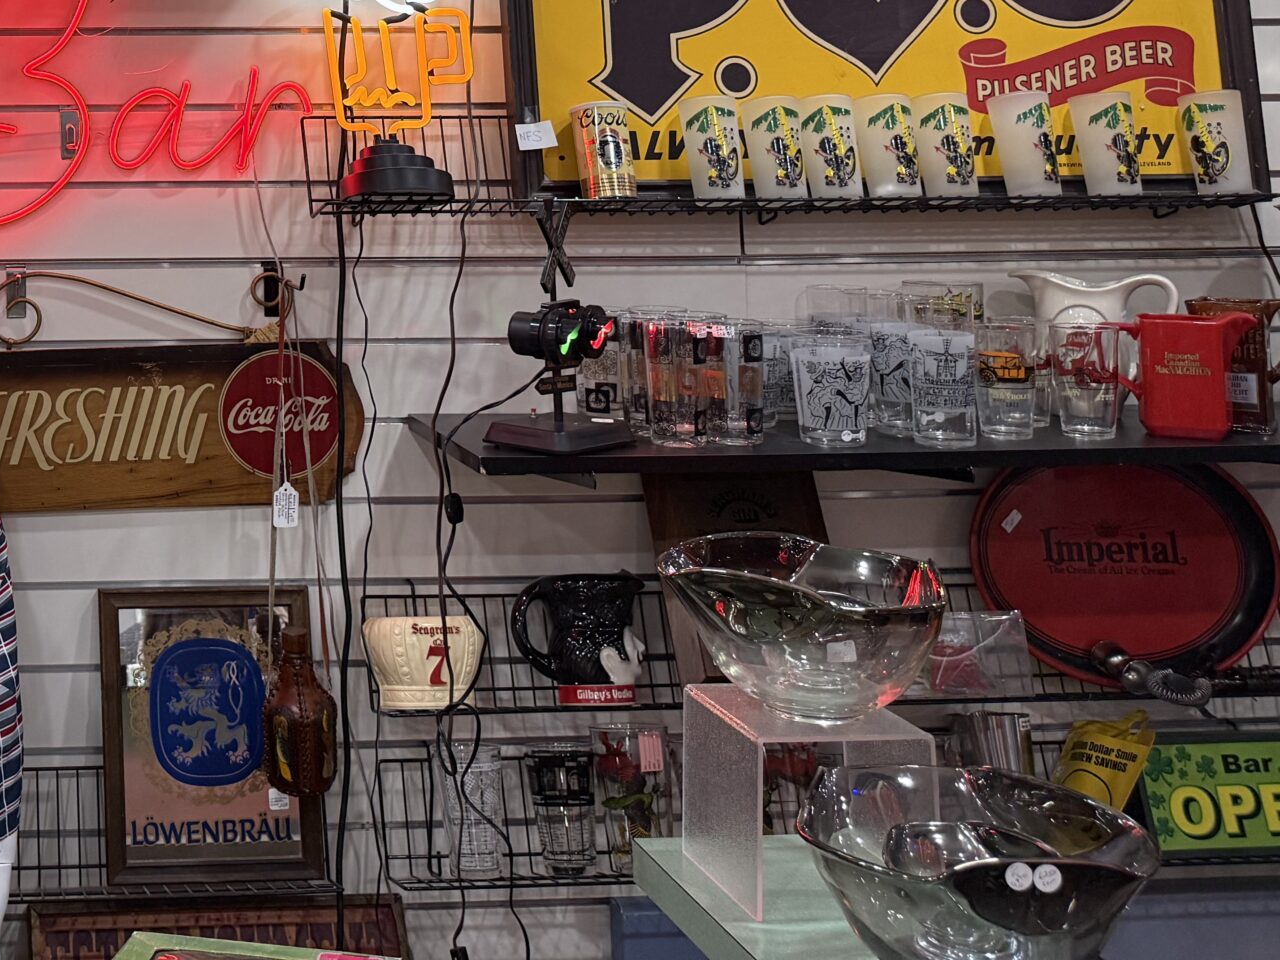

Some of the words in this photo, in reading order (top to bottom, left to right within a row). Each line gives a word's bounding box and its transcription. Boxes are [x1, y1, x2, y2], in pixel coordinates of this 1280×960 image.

[976, 53, 1098, 102] PILSENER
[1104, 39, 1174, 72] BEER
[1039, 526, 1188, 566] Imperial
[426, 644, 450, 686] 7
[576, 689, 611, 701] Gilbey's
[1088, 741, 1114, 756] Dollar
[1115, 748, 1138, 762] Smile
[1221, 753, 1273, 774] Bar
[130, 812, 294, 846] LÖWENBRÄU
[1170, 783, 1280, 841] OPE
